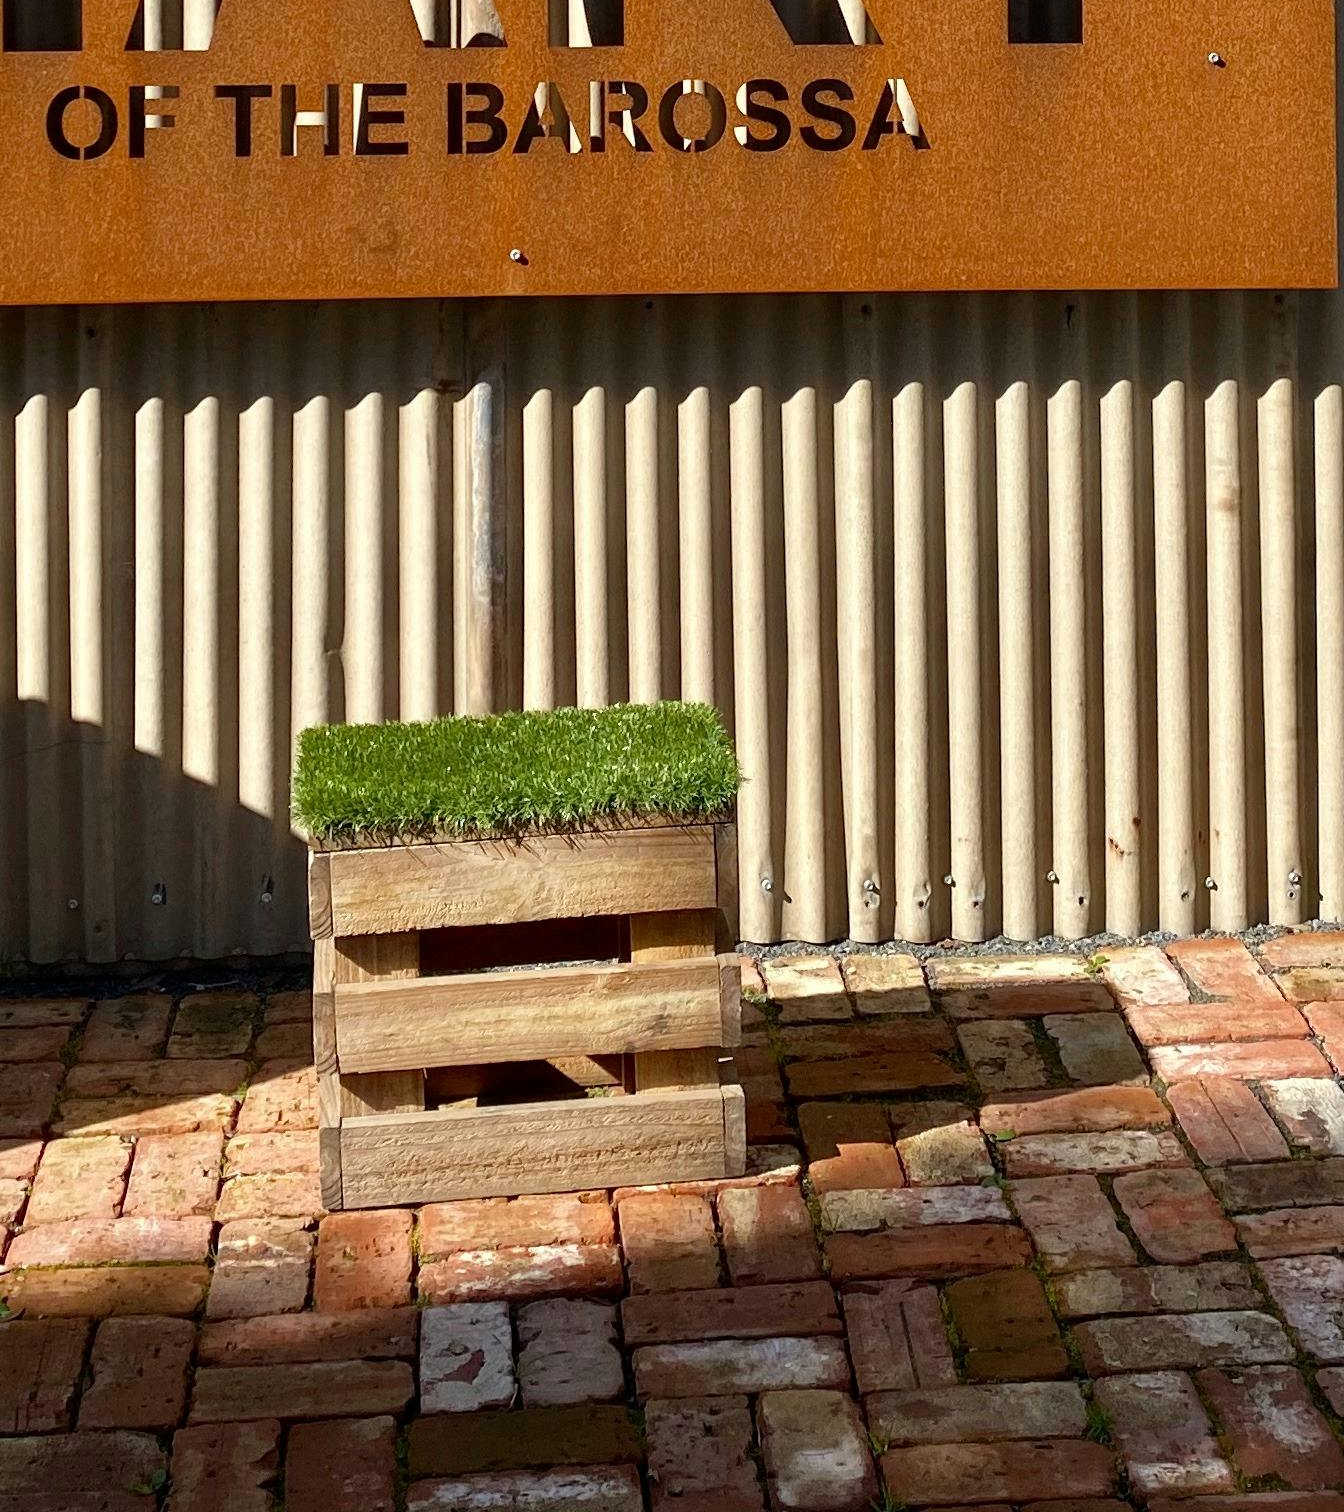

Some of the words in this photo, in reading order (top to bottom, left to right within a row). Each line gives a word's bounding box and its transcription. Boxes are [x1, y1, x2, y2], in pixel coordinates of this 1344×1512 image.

[49, 85, 176, 159] OF
[216, 83, 407, 157] THE
[447, 77, 932, 154] BAROSSA
